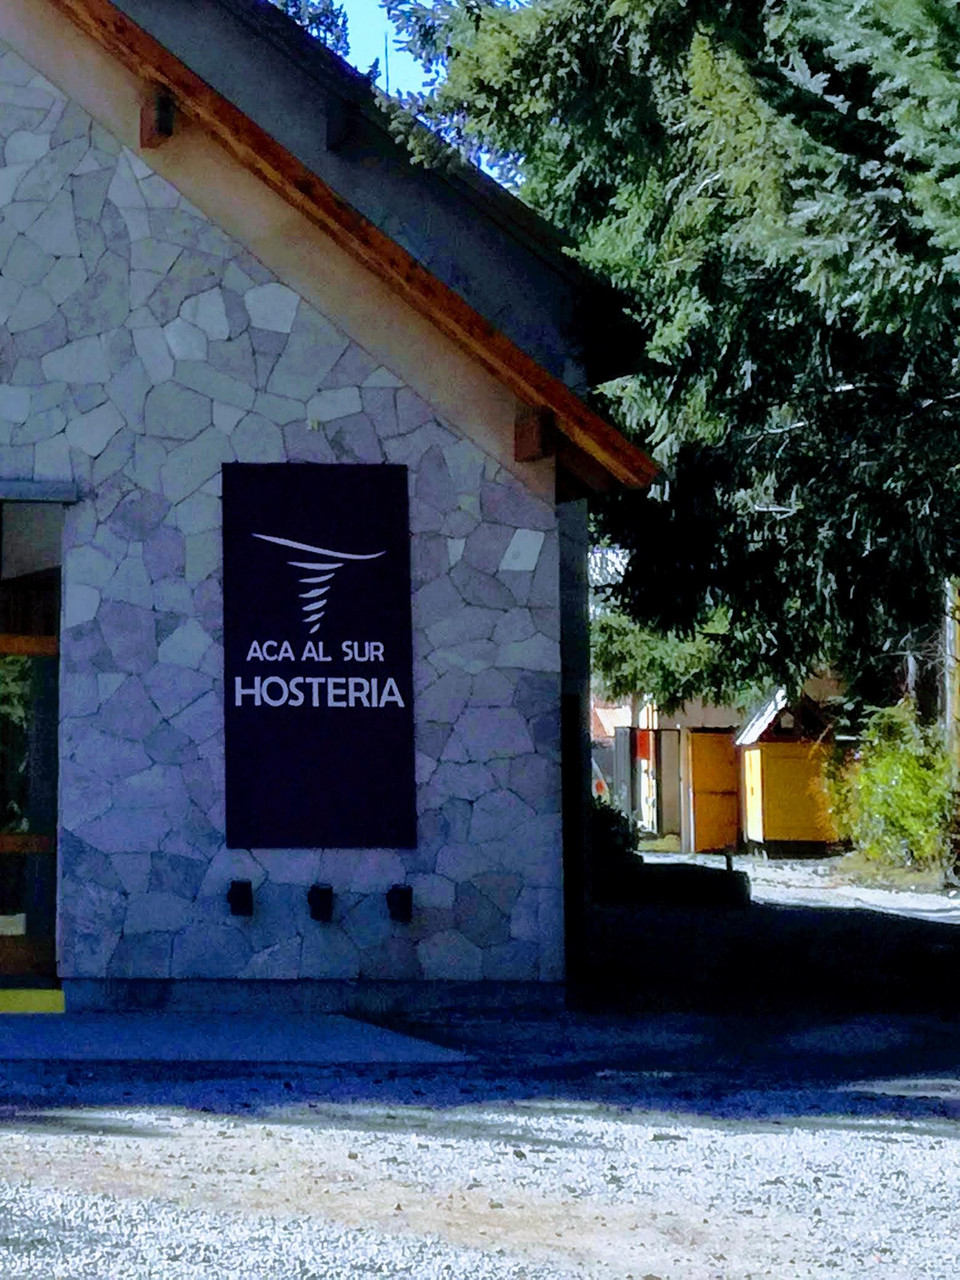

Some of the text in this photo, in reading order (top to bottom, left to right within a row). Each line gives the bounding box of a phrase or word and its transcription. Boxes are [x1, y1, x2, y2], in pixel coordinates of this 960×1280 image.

[246, 640, 385, 662] ACA AL SUR
[234, 675, 405, 708] HOSTERIA
